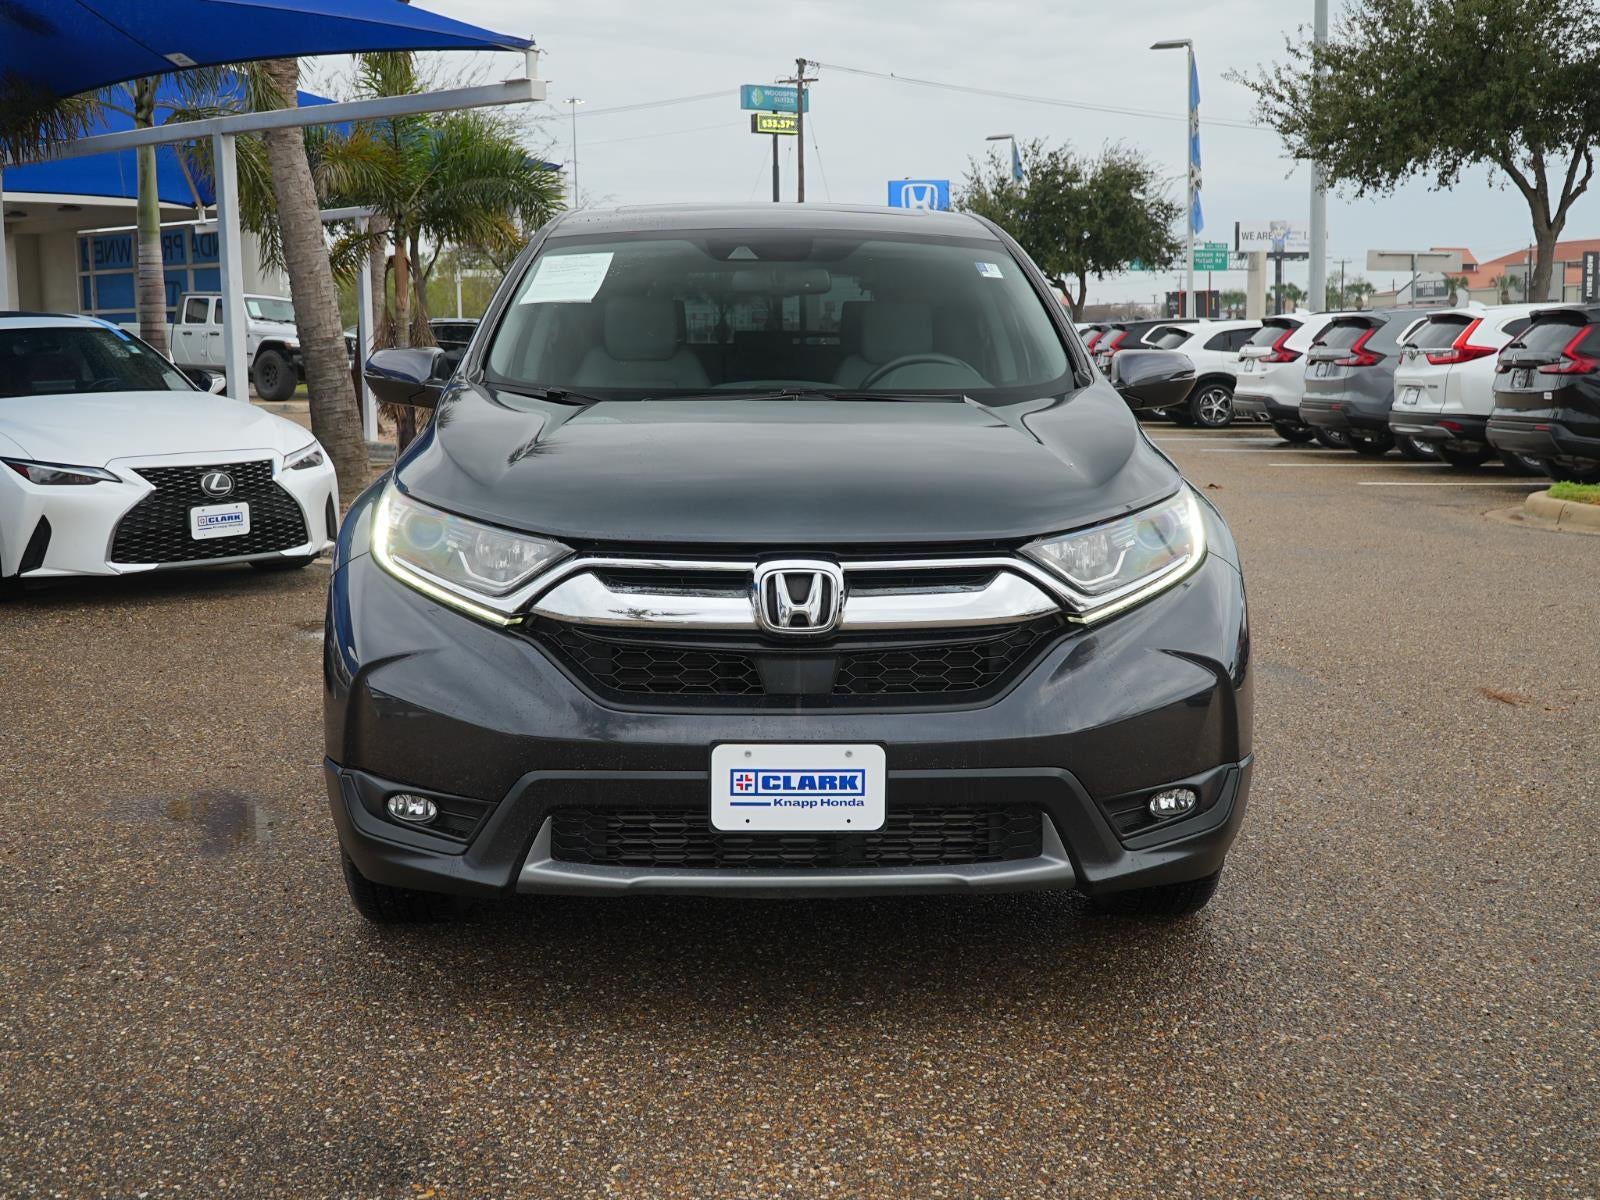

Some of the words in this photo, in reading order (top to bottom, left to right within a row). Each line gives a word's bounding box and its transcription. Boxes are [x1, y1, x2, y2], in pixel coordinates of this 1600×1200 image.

[1241, 231, 1255, 241] WE
[1256, 231, 1272, 240] ARE
[207, 514, 241, 524] CLARK
[761, 775, 859, 790] CLARK
[773, 798, 818, 809] Knapp
[820, 798, 865, 807] Honda
